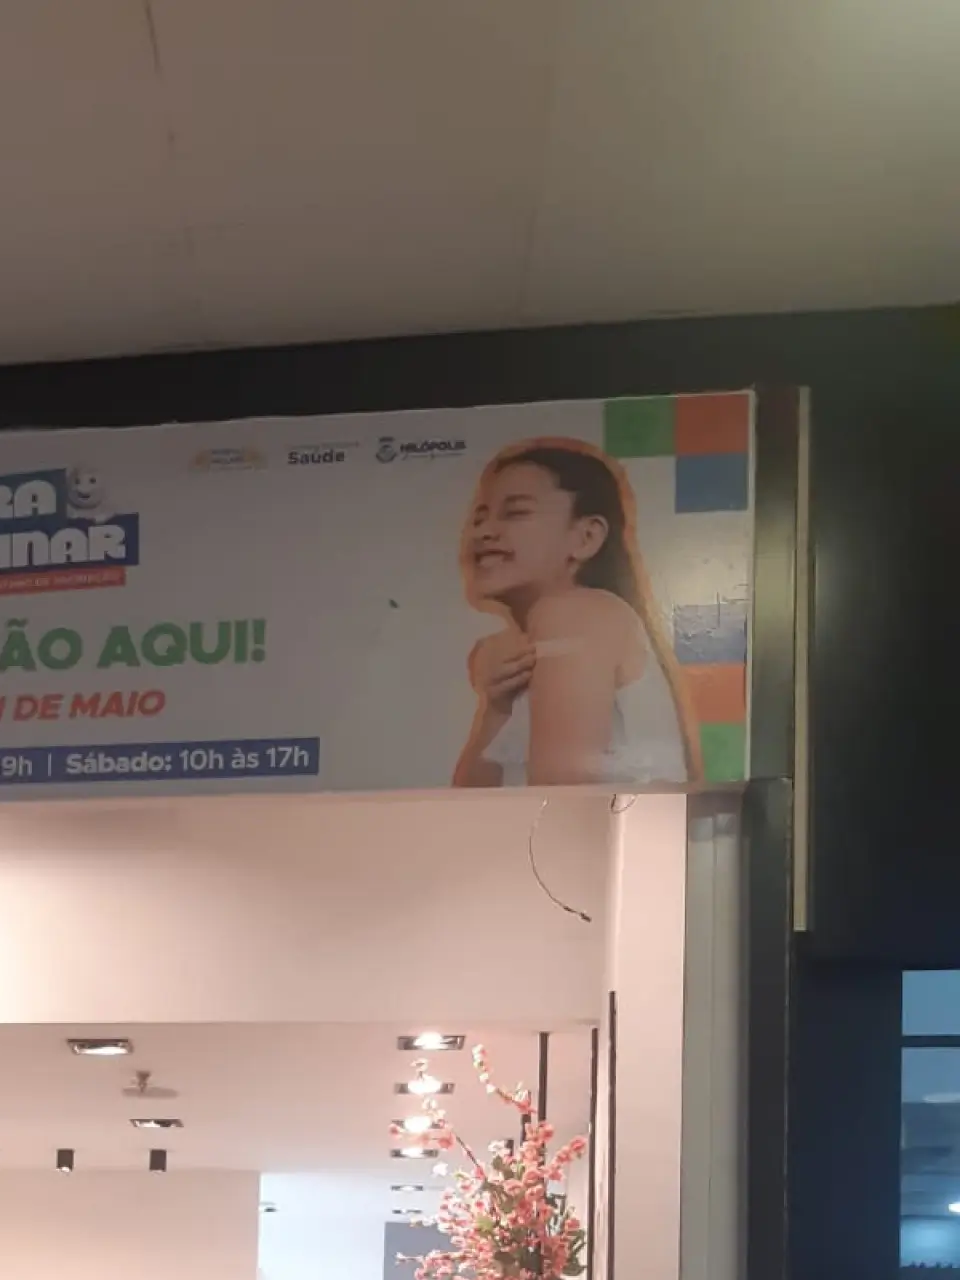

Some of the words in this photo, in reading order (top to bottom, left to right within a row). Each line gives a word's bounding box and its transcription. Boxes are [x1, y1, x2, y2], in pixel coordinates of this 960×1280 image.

[96, 618, 267, 668] AQUI!
[12, 694, 64, 722] DE
[68, 689, 167, 719] MAIO
[66, 751, 172, 774] Sábado:
[179, 749, 224, 772] 10h
[231, 747, 259, 770] às
[266, 746, 310, 769] 17h
